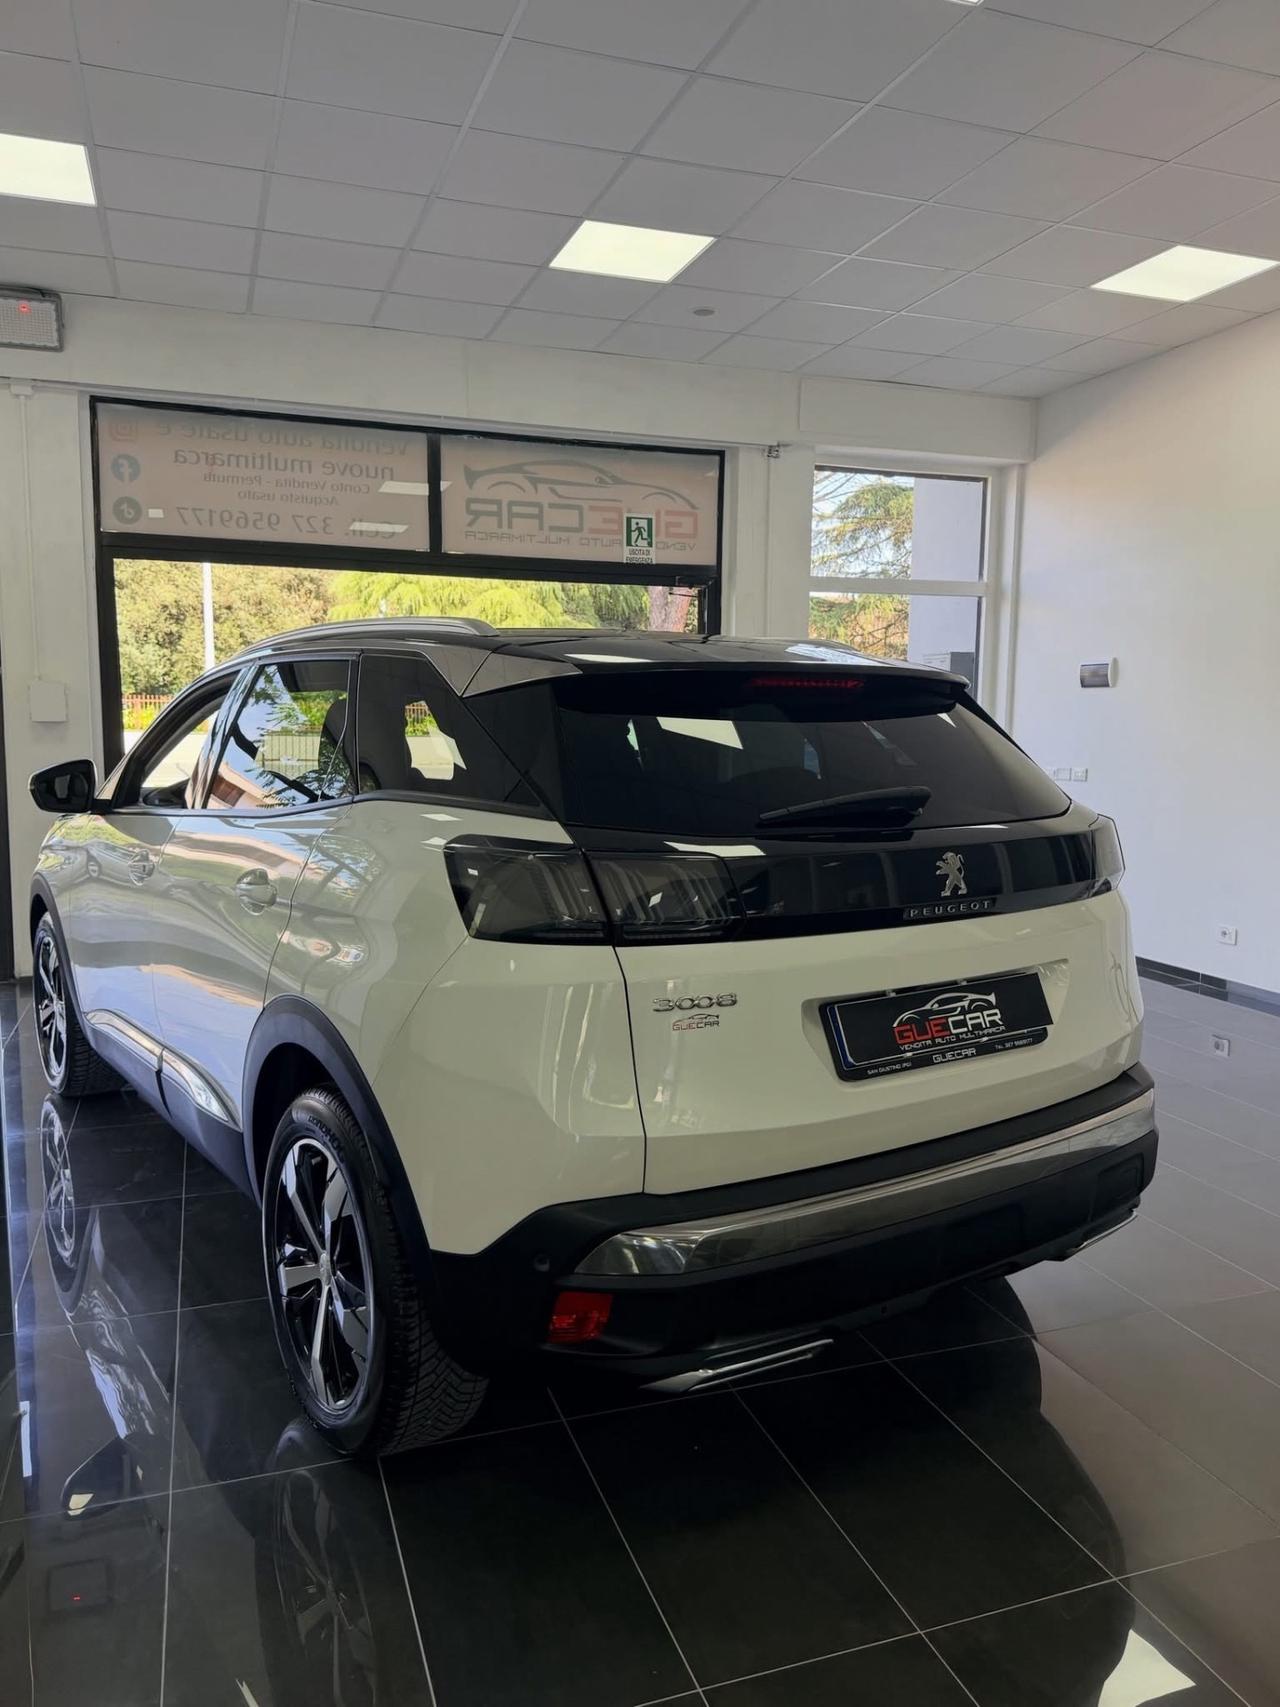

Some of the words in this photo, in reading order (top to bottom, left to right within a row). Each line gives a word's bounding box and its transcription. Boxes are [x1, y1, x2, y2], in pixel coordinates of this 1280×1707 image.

[910, 901, 990, 917] PEUGEOT
[653, 993, 738, 1012] 3008
[672, 1020, 720, 1031] GUECAR
[893, 1008, 1003, 1045] GUECAR
[935, 1035, 957, 1045] AUTO
[959, 1026, 1006, 1040] MULTIMARCA
[932, 1048, 977, 1063] GUECAR
